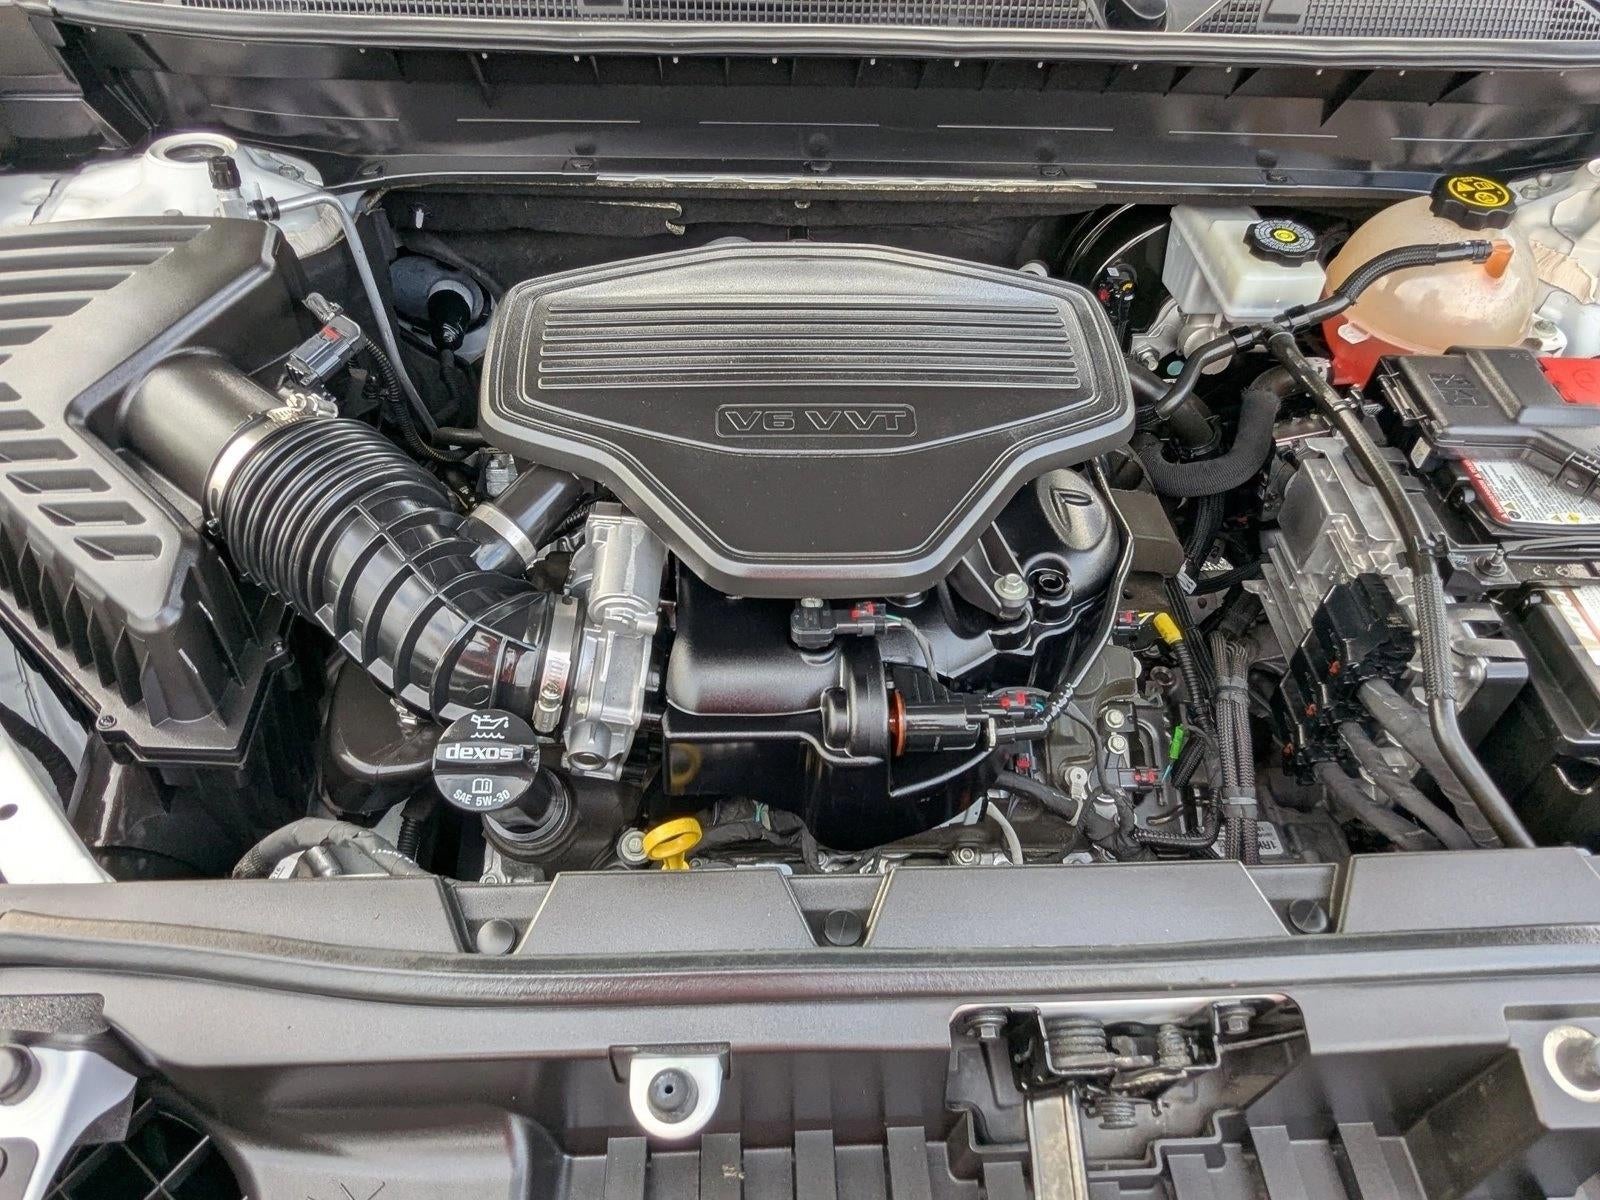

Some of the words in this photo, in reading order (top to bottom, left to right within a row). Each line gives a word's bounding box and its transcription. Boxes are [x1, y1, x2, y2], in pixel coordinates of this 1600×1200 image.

[725, 410, 795, 430] V6
[804, 410, 907, 430] VVT
[445, 743, 514, 760] dexos
[453, 789, 473, 804] SAE
[475, 789, 511, 807] 5W-30
